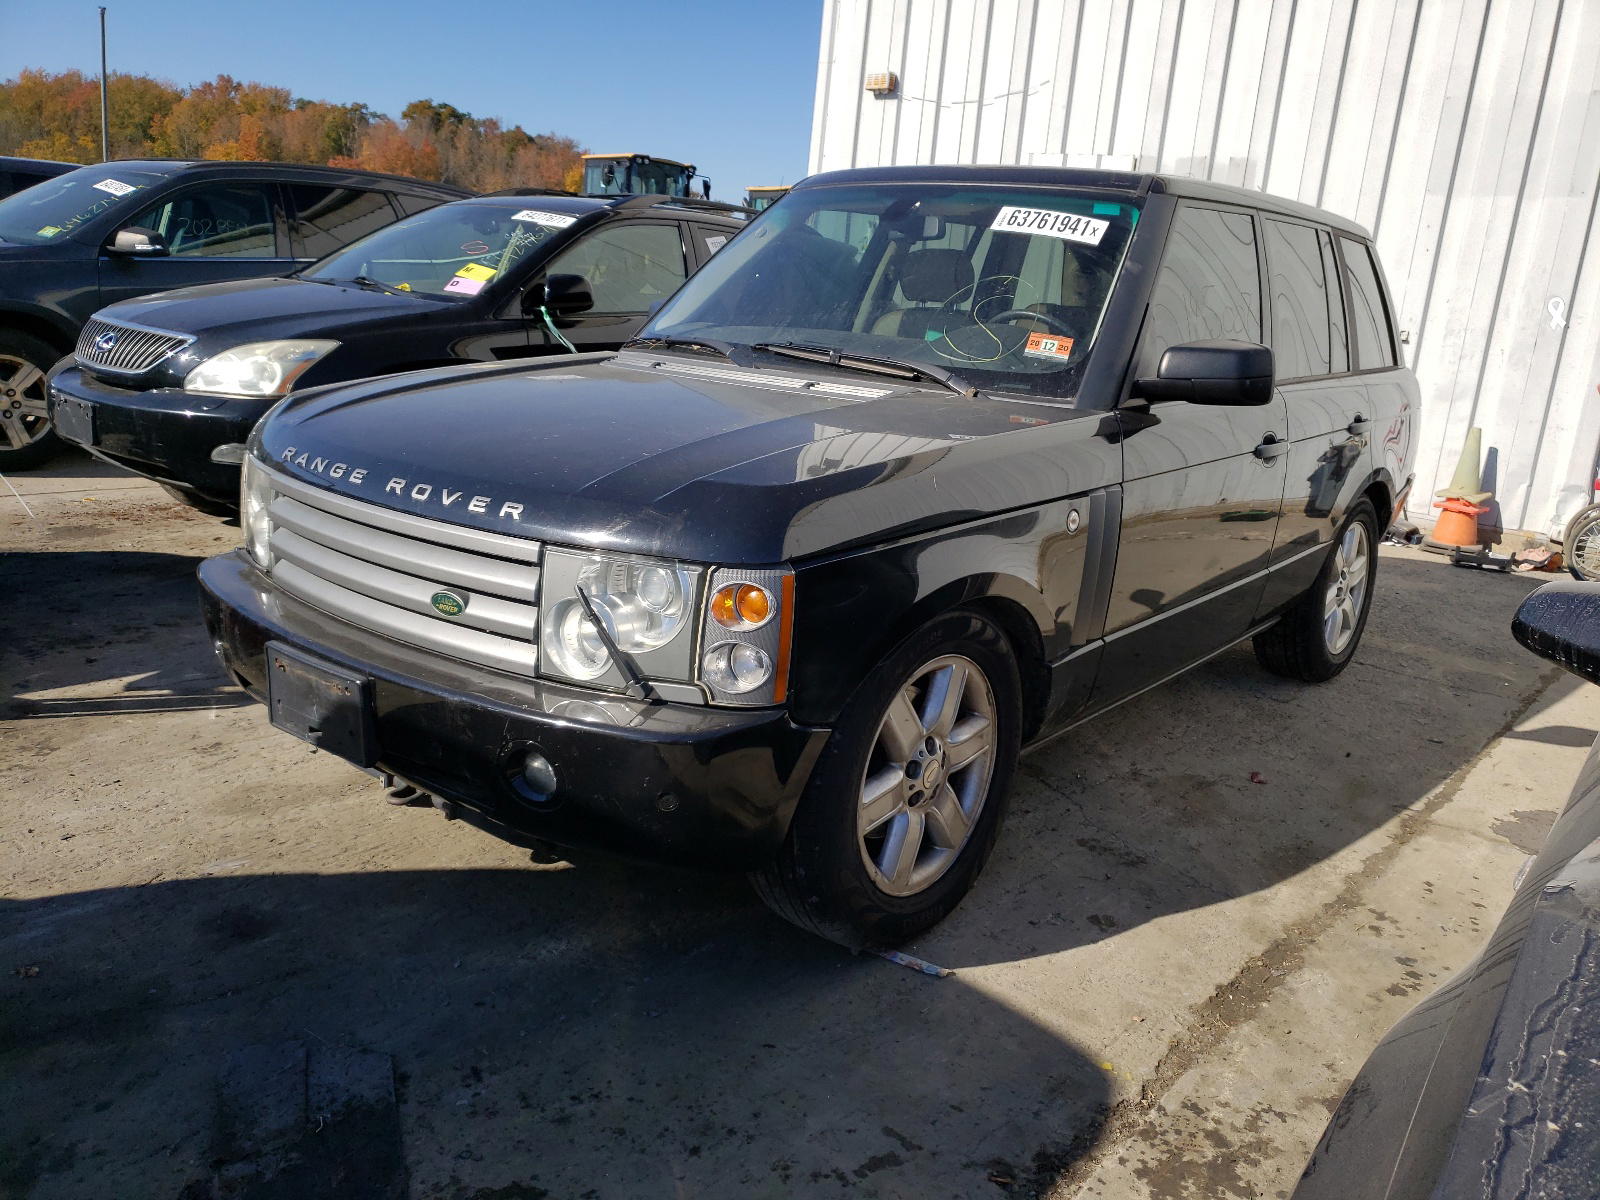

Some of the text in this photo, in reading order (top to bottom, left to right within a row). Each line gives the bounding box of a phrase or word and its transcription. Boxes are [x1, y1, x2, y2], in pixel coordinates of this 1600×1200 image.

[1042, 341, 1055, 351] 12
[281, 446, 524, 520] RANGE ROVER
